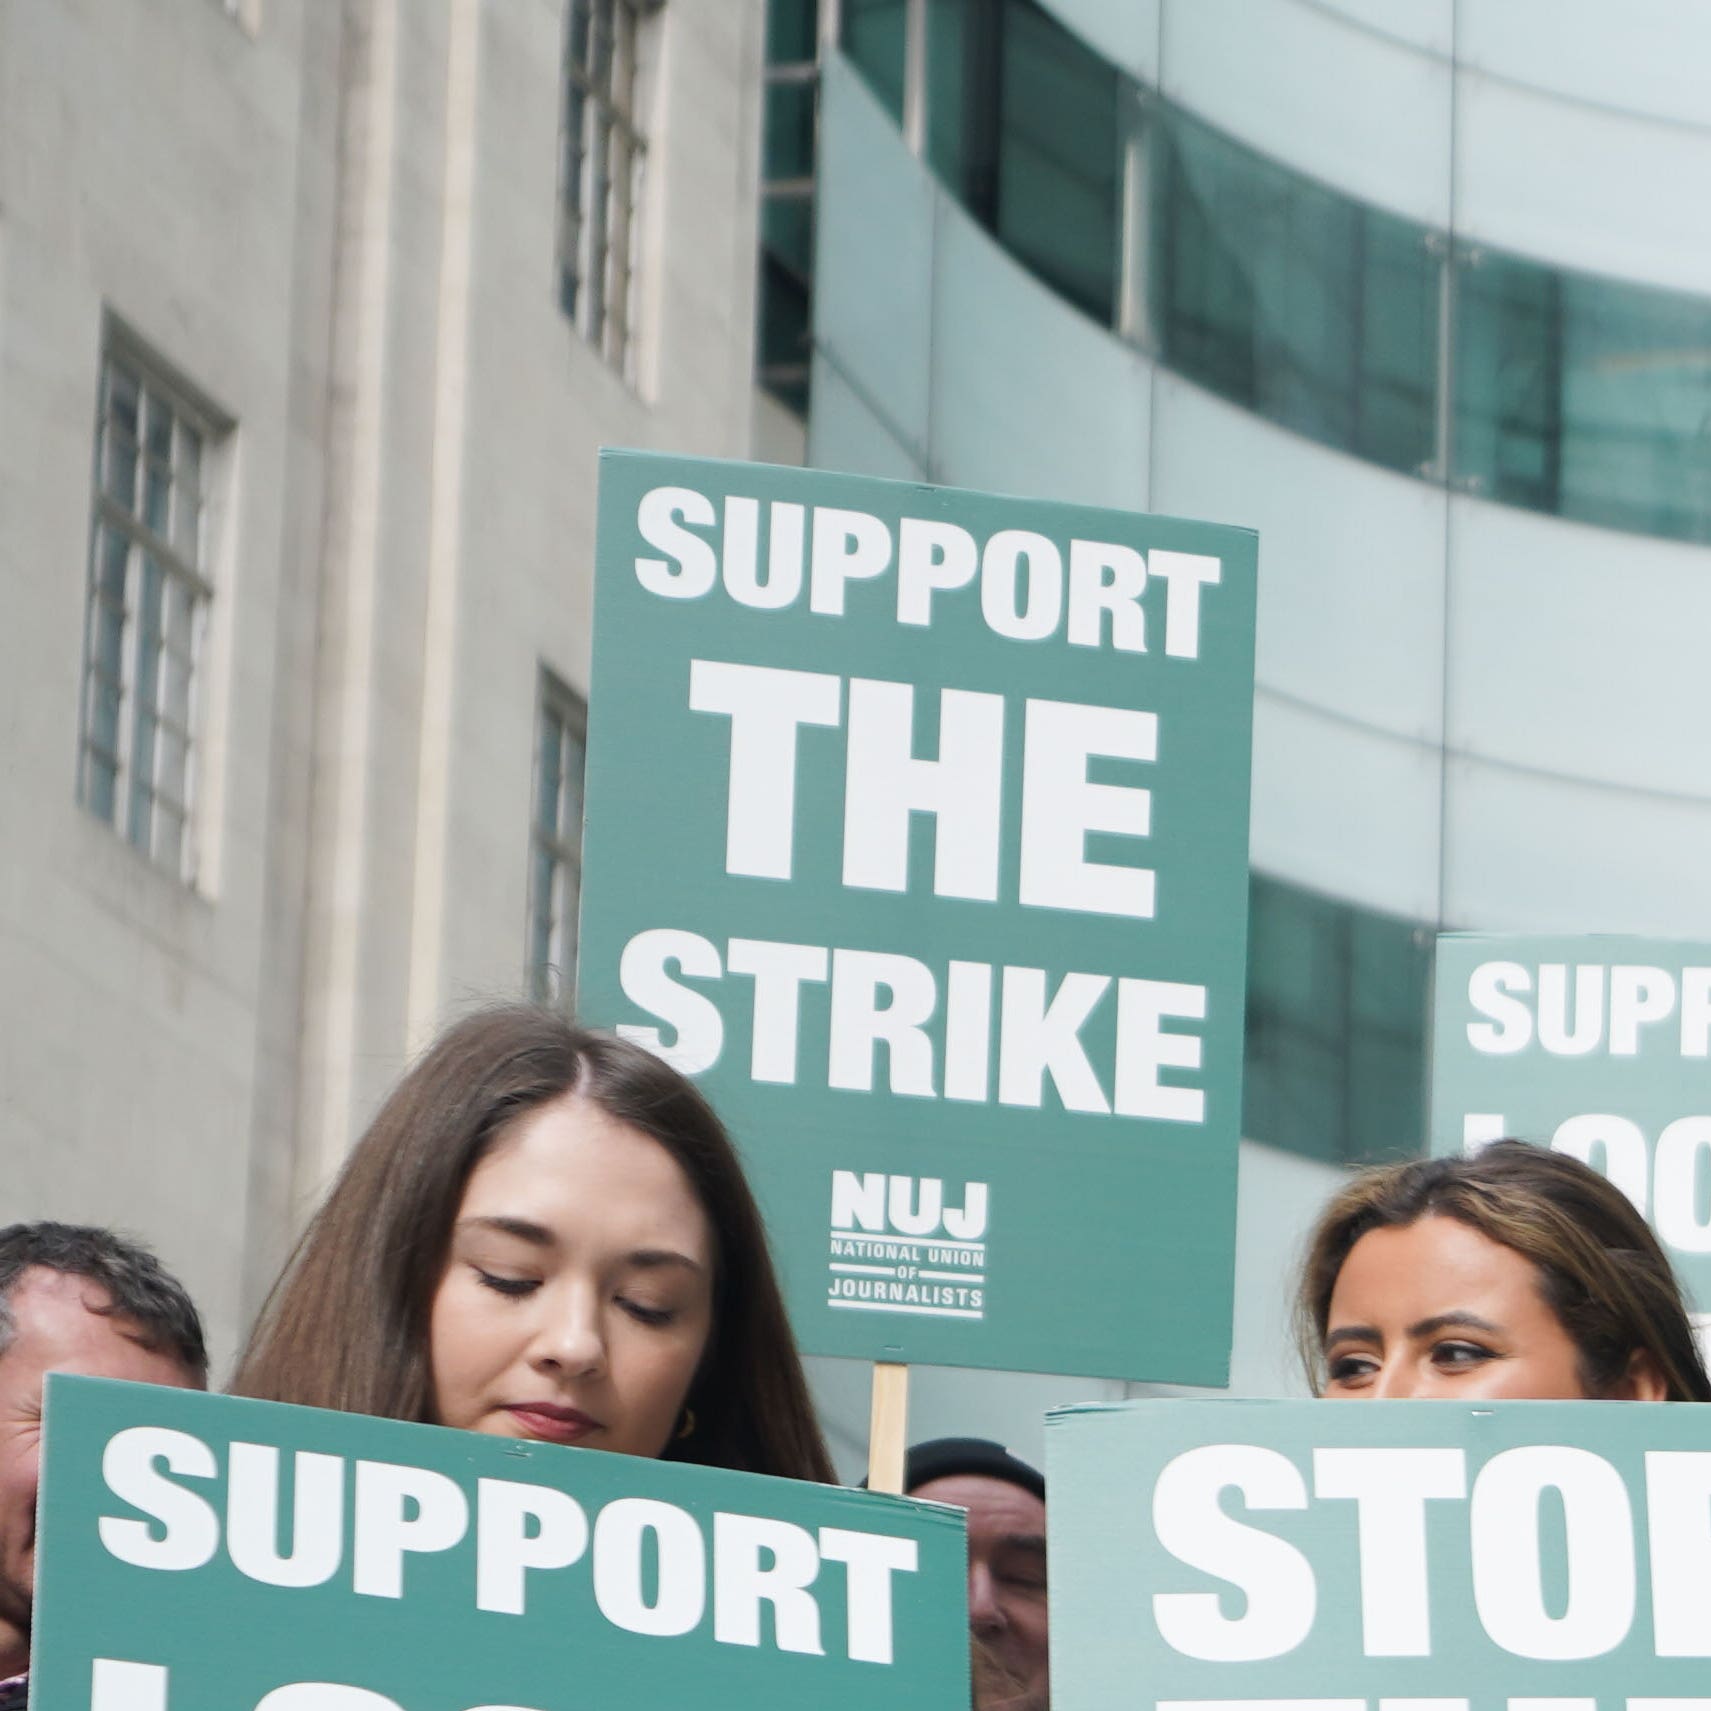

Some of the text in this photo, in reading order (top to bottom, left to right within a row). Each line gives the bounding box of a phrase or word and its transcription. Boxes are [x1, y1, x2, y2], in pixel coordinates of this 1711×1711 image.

[634, 486, 1222, 659] SUPPORT
[689, 659, 1159, 919] THE
[615, 928, 1207, 1123] STRIKE
[830, 1240, 985, 1267] NATIONAL UNION
[831, 1169, 988, 1240] NUJ
[828, 1278, 983, 1307] JOURNALISTS
[897, 1266, 919, 1280] OF
[98, 1426, 919, 1665] SUPPORT
